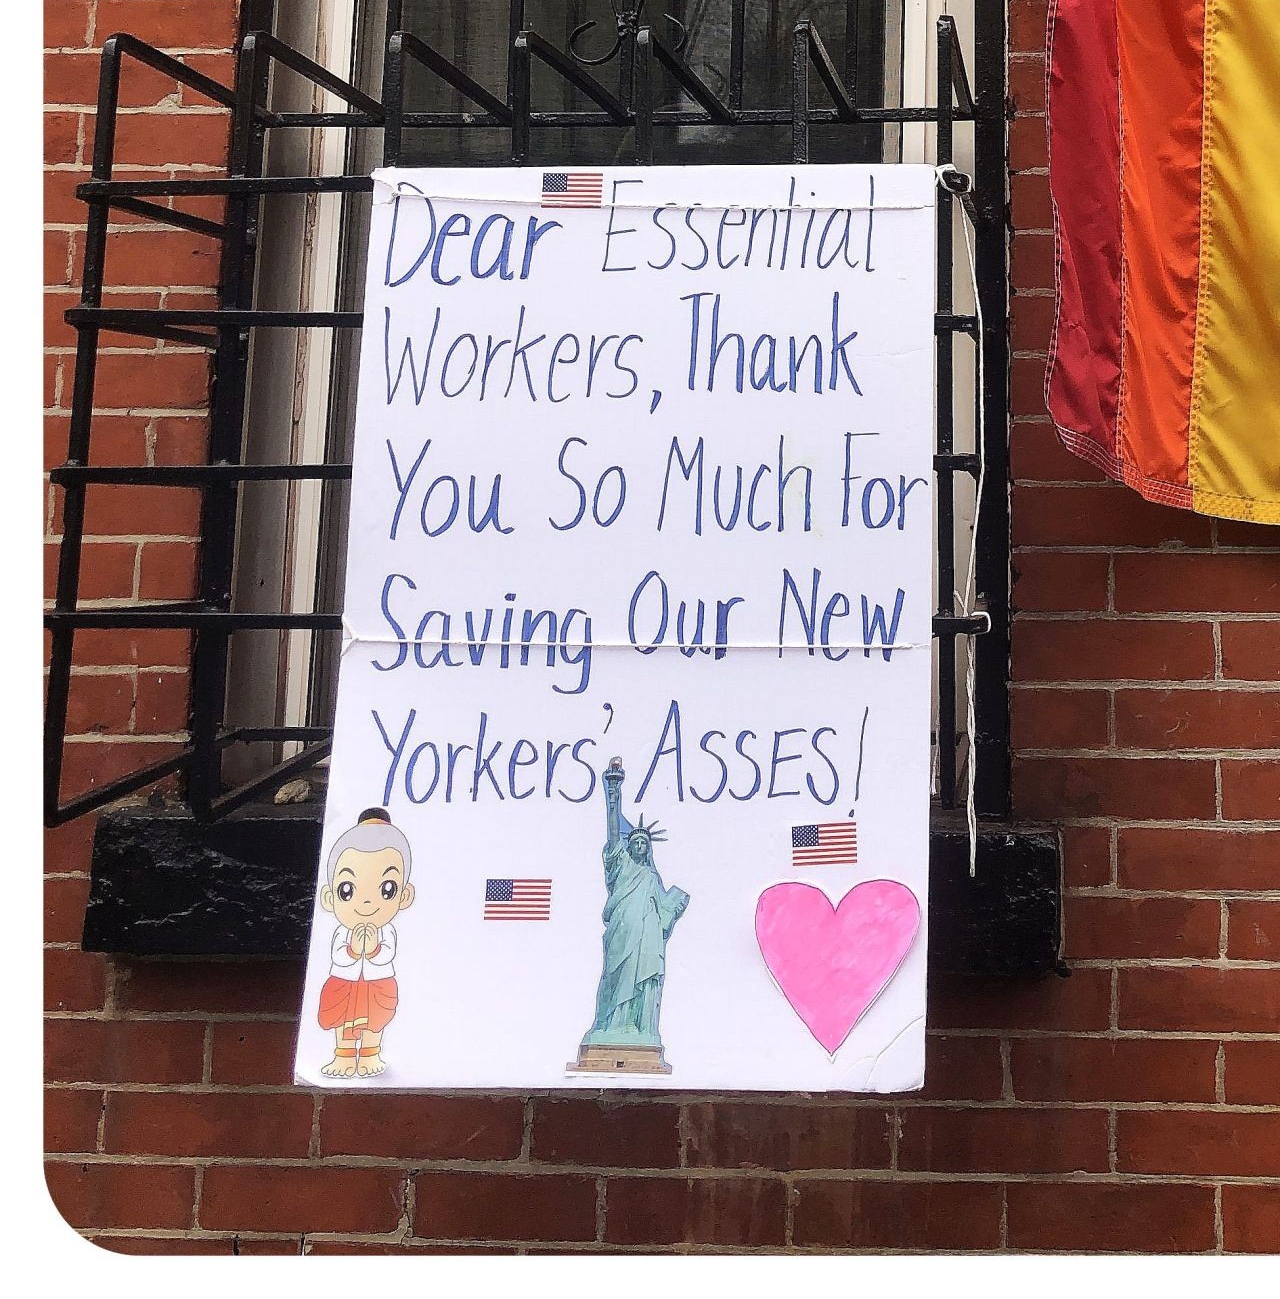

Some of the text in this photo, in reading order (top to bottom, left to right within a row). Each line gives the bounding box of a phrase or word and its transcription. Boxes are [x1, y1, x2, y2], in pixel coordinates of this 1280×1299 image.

[383, 178, 876, 288] Dear Essential
[383, 291, 864, 415] Workers, Thank
[386, 431, 929, 541] You So Much For
[370, 568, 906, 695] Saving Our New
[371, 701, 615, 806] Yorkers'
